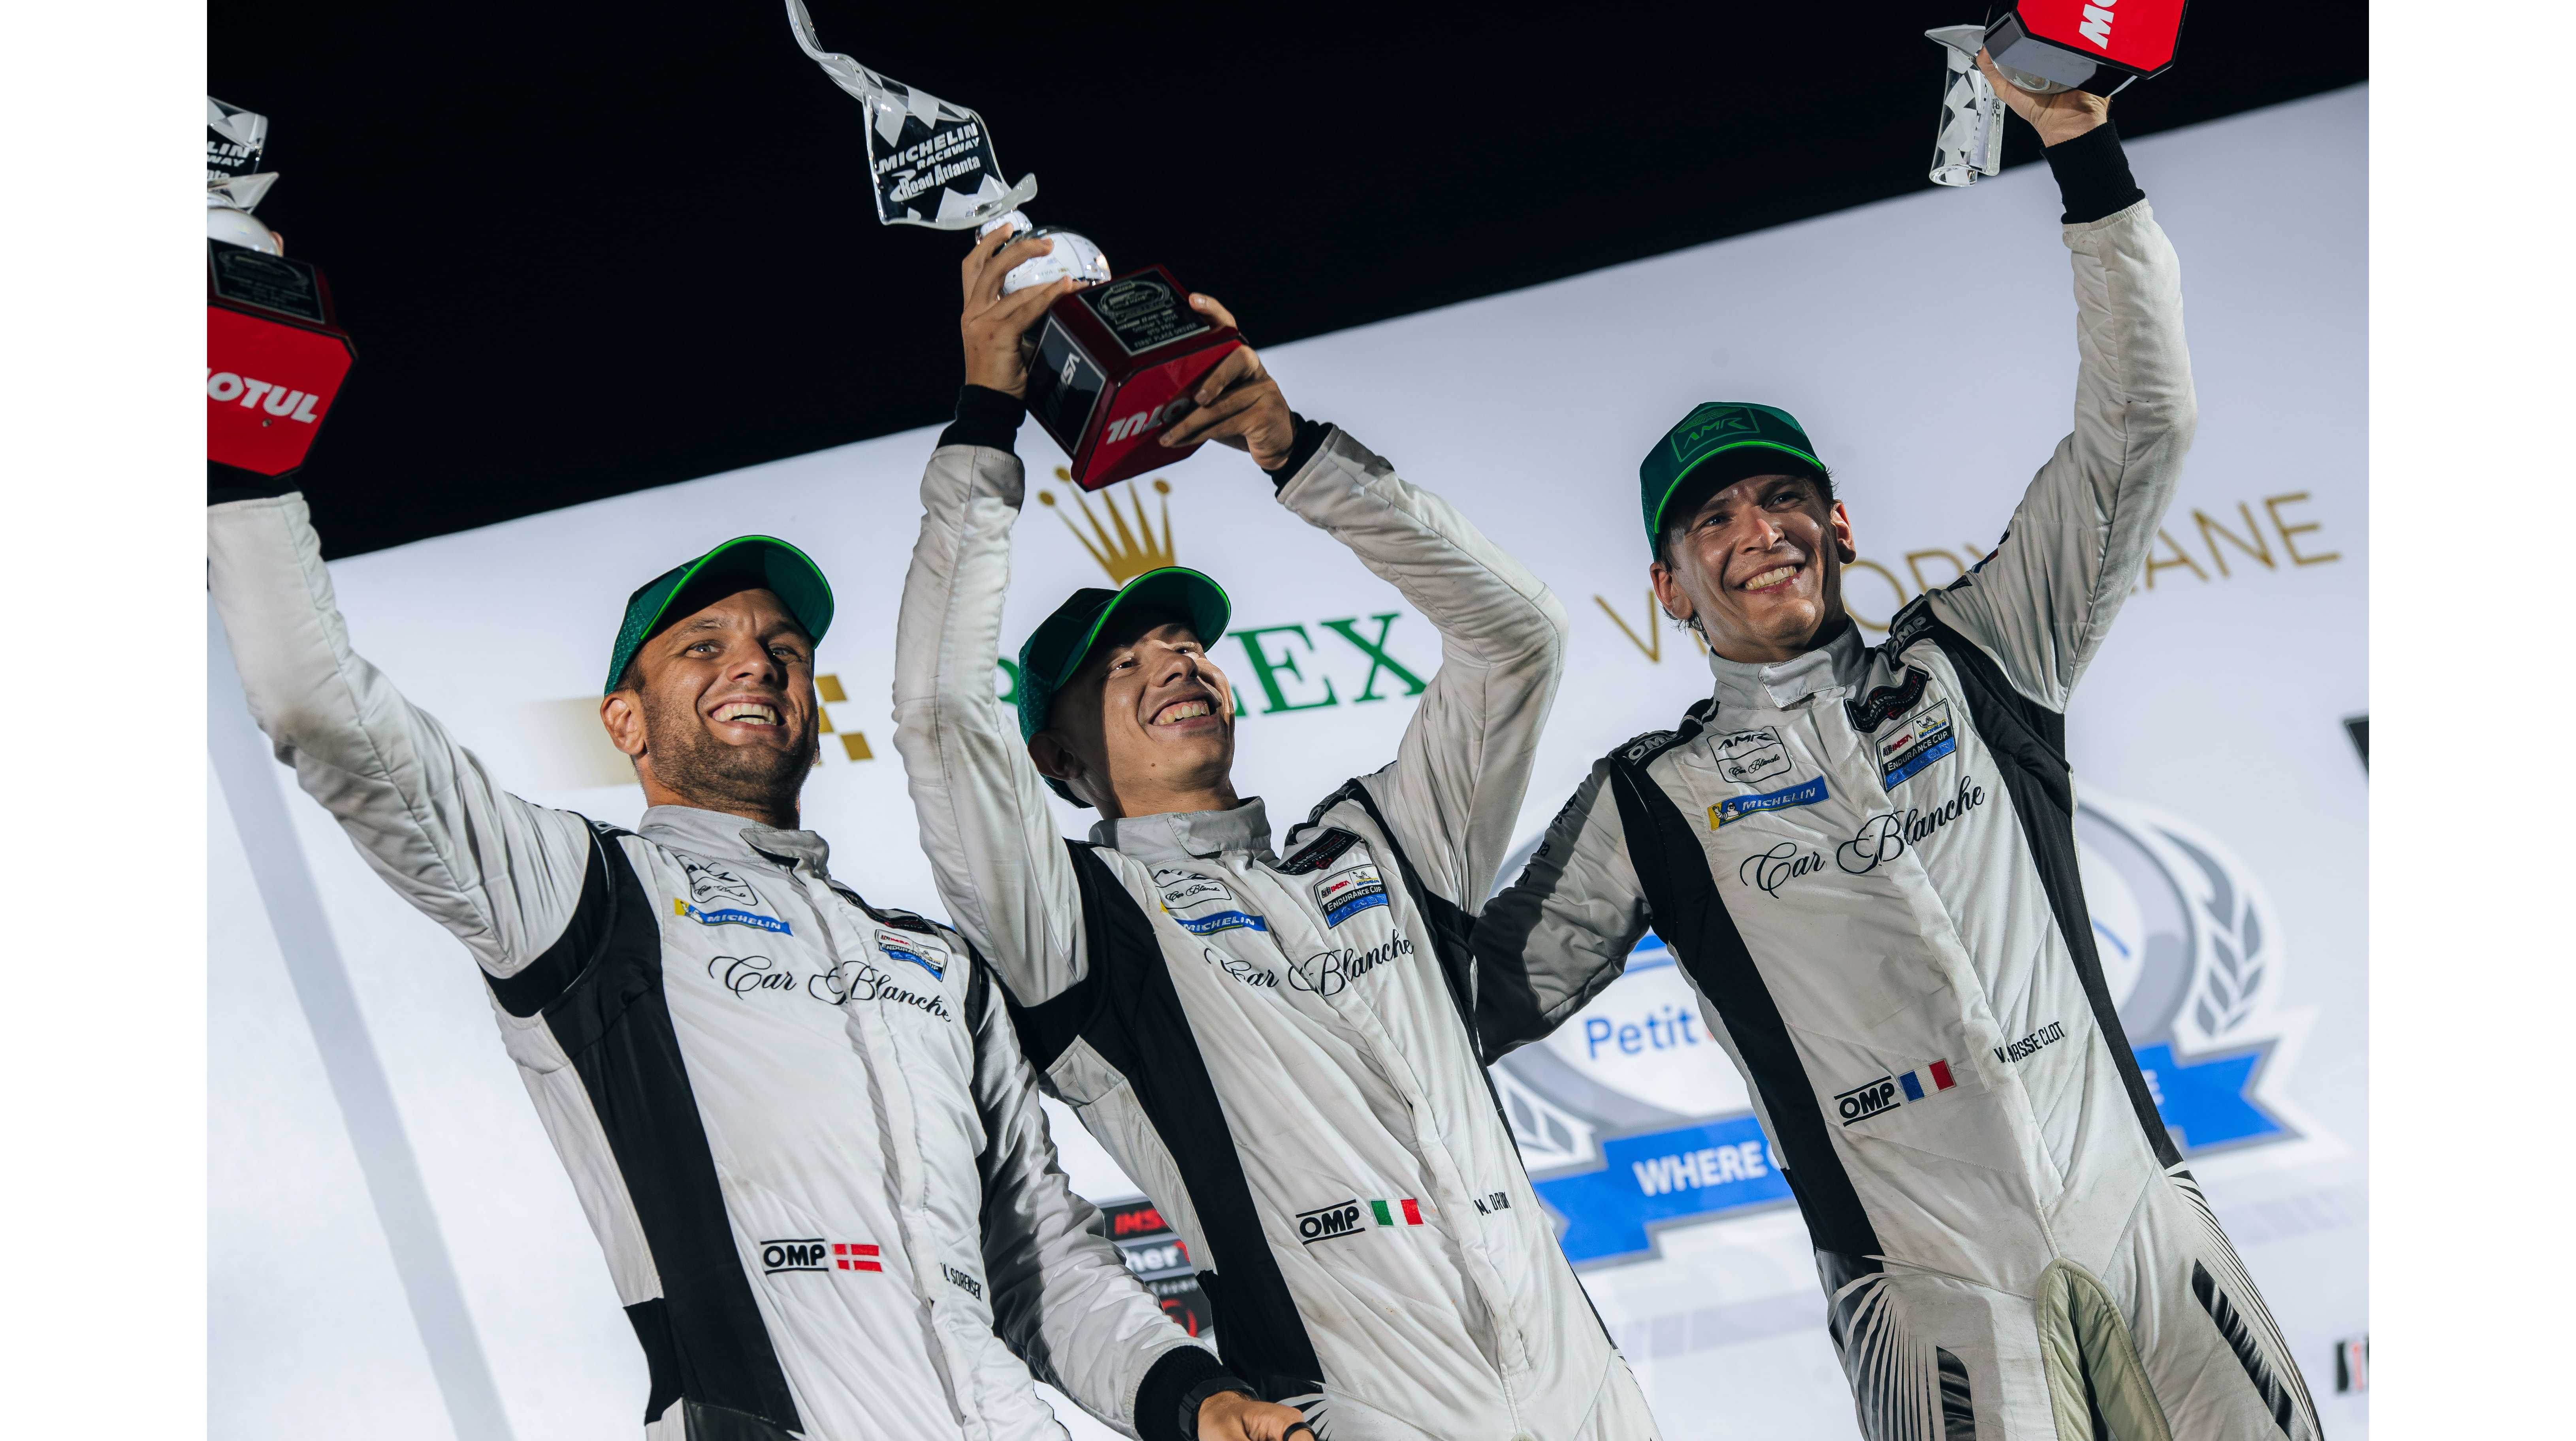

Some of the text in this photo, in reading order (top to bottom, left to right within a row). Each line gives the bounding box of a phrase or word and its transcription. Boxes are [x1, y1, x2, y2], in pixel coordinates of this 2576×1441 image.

[878, 122, 978, 174] MICHELIN
[917, 137, 980, 170] RACEWAY
[898, 155, 981, 200] Road Atlanta
[207, 367, 319, 424] OTUL
[1106, 397, 1190, 445] OTUL
[2127, 491, 2342, 596] ANE
[1888, 740, 1932, 771] ENDURANCE
[1742, 787, 1815, 811] MICHELIN
[1740, 775, 1986, 899] Car Blanche
[1327, 888, 1370, 912] ENDURANCE
[706, 914, 781, 931] MICHELIN
[1184, 916, 1255, 932] MICHELIN
[1288, 929, 1414, 997] Blanche
[708, 955, 951, 1023] Car Blanche
[1586, 1006, 1699, 1061] Petit
[2038, 1021, 2066, 1045] CLOT
[1839, 1083, 1896, 1119] OMP
[1632, 1140, 1768, 1198] WHERE
[1299, 1205, 1360, 1238] OMP
[763, 1244, 826, 1268] OMP
